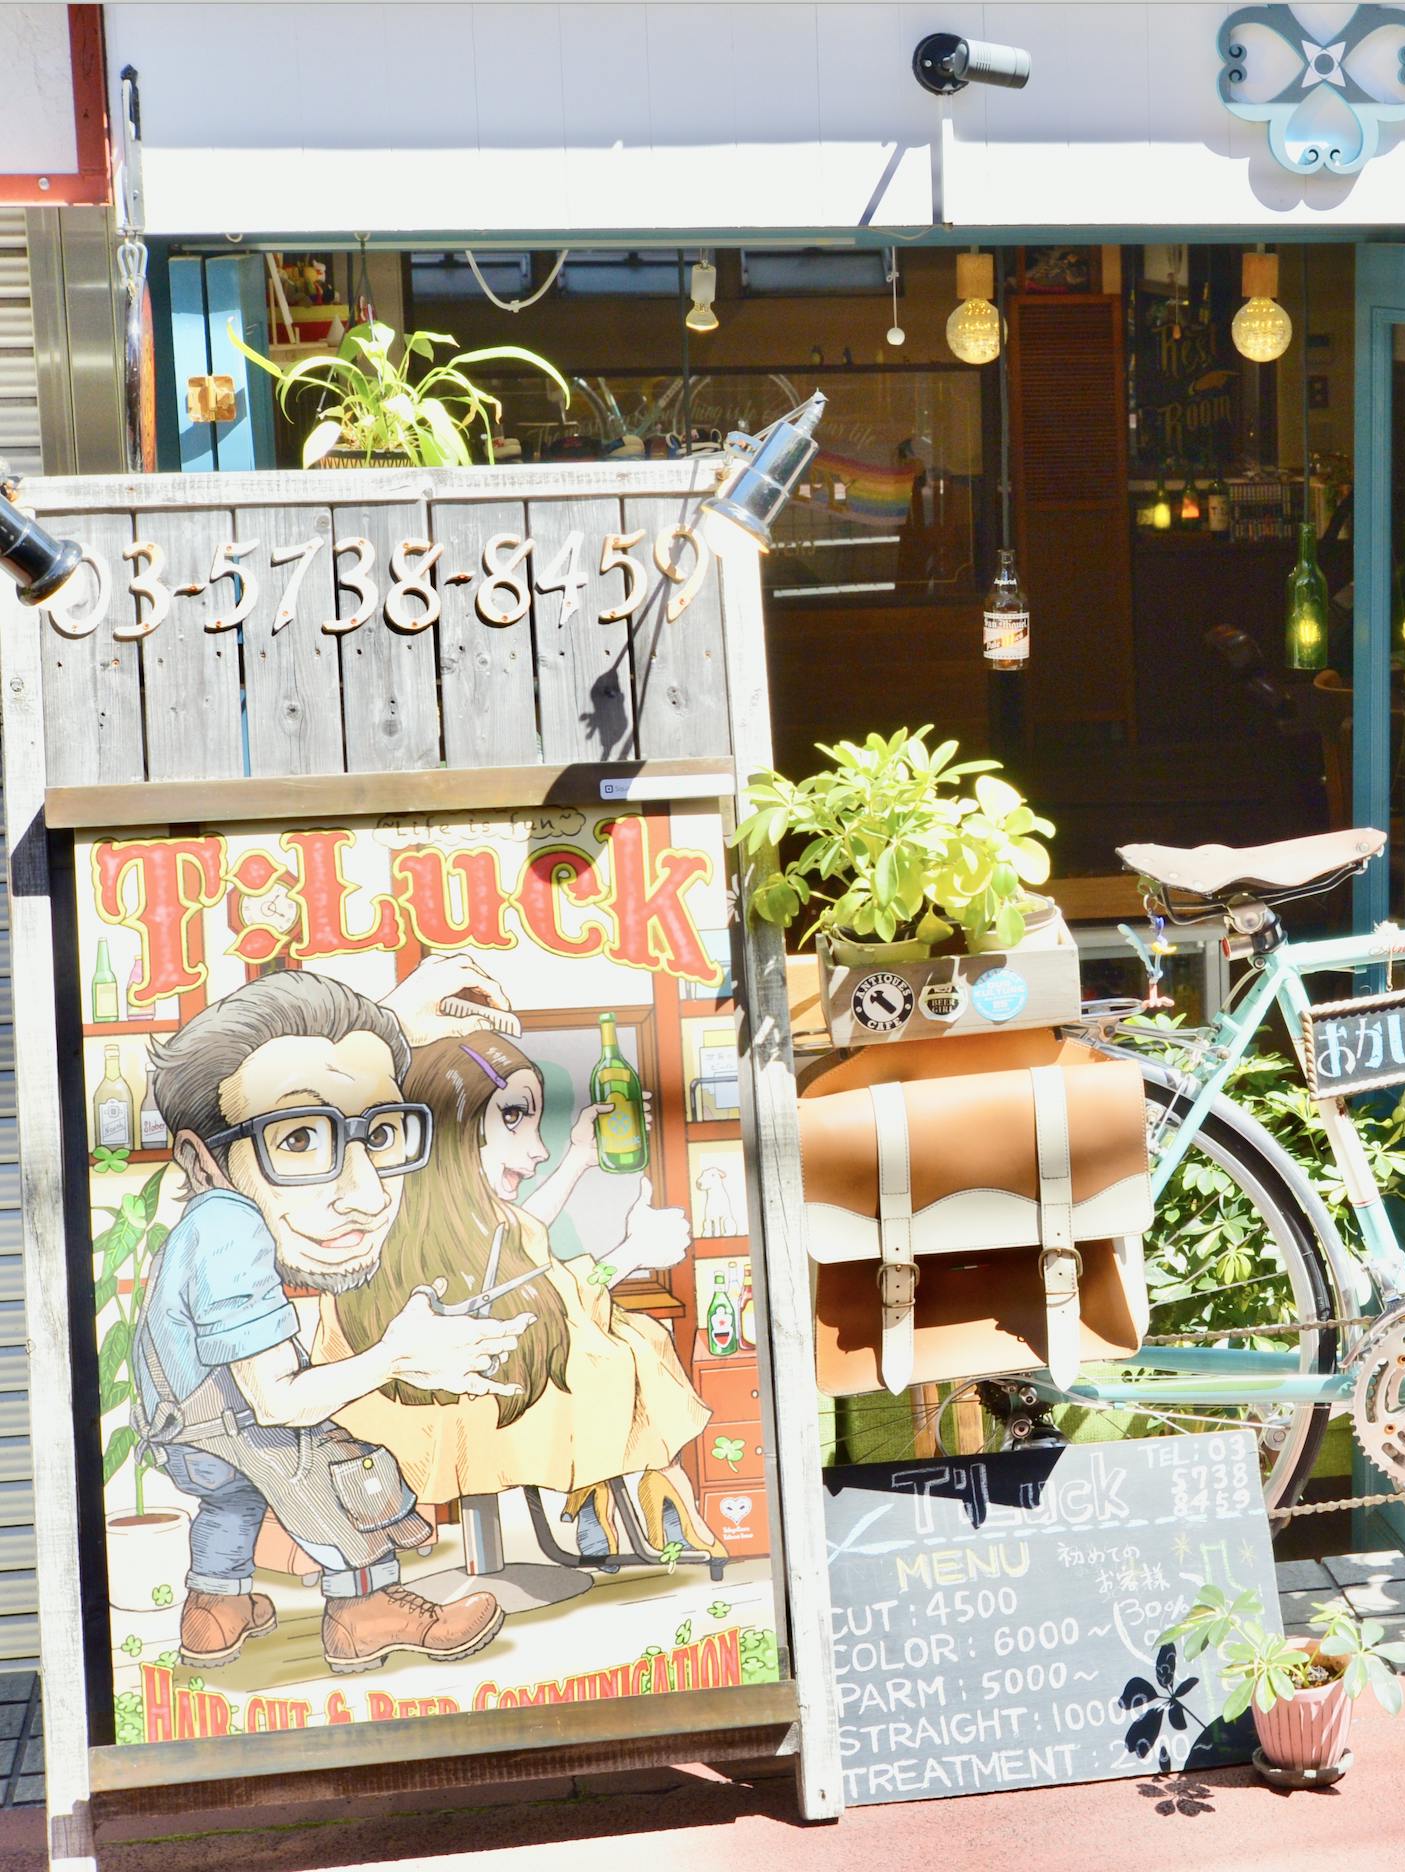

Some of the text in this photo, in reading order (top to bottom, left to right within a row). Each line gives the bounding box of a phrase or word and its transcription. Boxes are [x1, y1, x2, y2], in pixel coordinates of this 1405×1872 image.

[47, 522, 702, 640] 03-5738-8459
[469, 819, 490, 833] is
[92, 814, 725, 1006] T:Luck
[855, 974, 911, 999] ANTIQUES
[867, 1017, 903, 1031] CAFE
[895, 1541, 1030, 1592] MENU
[1057, 1542, 1140, 1567] 初めての
[1096, 1563, 1170, 1593] お客様
[926, 1587, 1018, 1626] 4500
